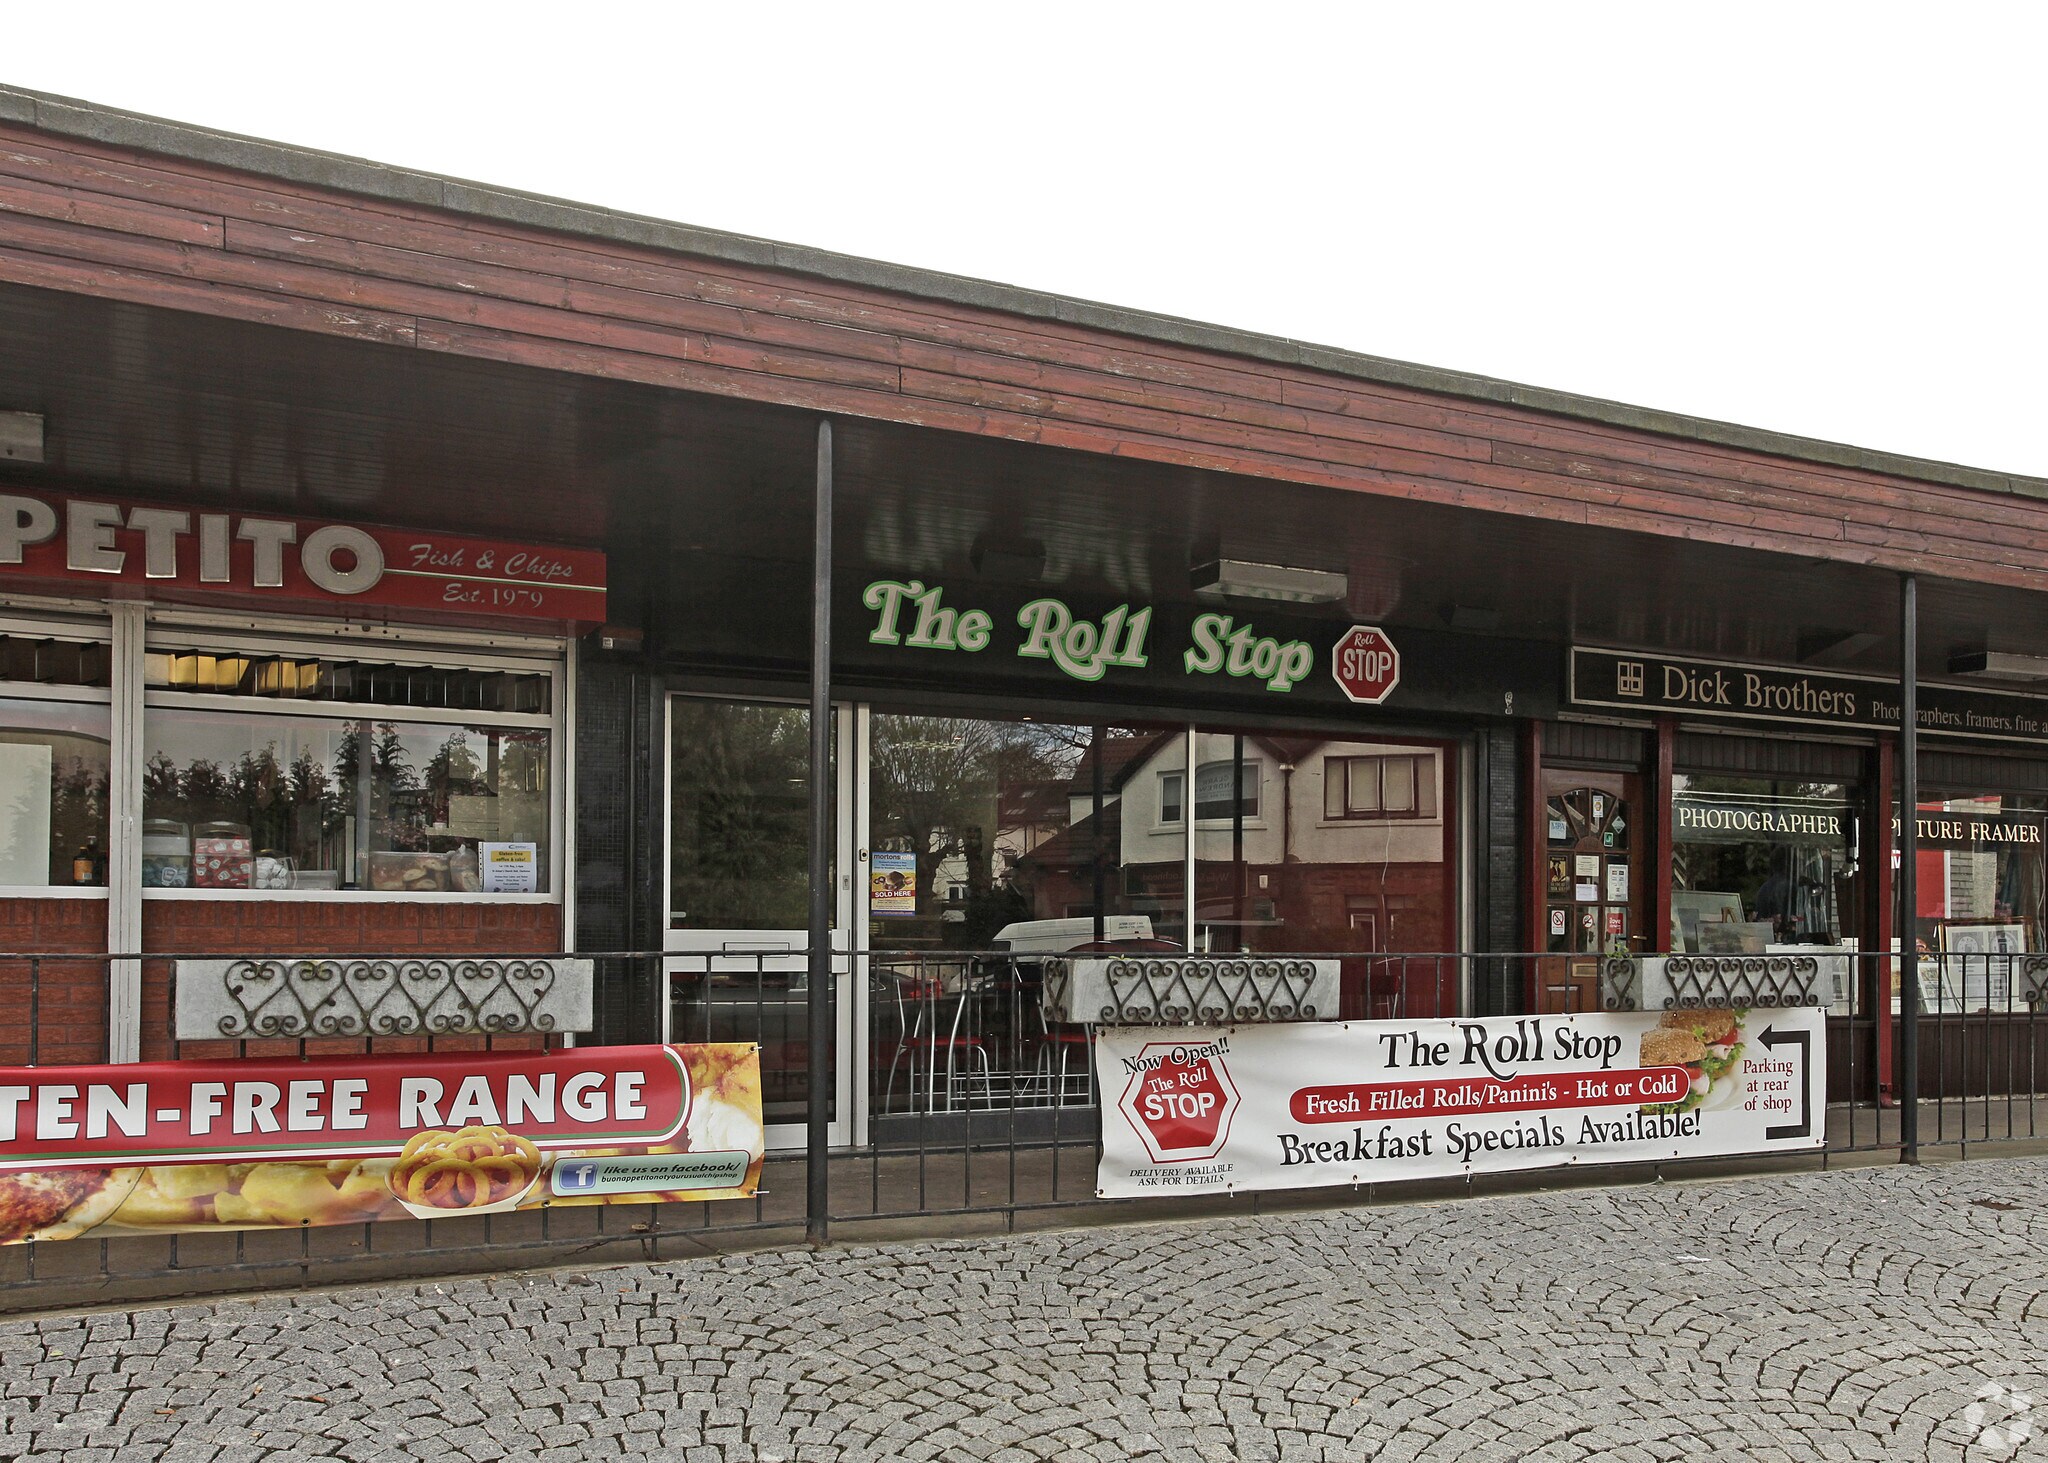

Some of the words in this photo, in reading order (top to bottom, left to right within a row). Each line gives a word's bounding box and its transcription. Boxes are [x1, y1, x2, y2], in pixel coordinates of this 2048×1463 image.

[409, 544, 464, 567] Fish
[476, 550, 495, 570] &
[504, 552, 573, 580] Chips
[862, 580, 993, 652] The
[1017, 598, 1152, 682] Roll
[1183, 612, 1313, 692] Stop
[1354, 633, 1375, 647] Roll
[1343, 648, 1392, 683] STOP
[1662, 665, 1731, 705] Dick
[1743, 673, 1856, 716] Brothers
[2015, 715, 2038, 733] fine
[1678, 807, 1841, 835] PHOTOGRAPHER
[1970, 822, 2040, 843] FRAMER
[1121, 1055, 1163, 1075] Now
[1170, 1036, 1230, 1066] Open!!
[1379, 1030, 1450, 1068] The
[1459, 1019, 1544, 1082] Roll
[1553, 1026, 1622, 1069] Stop
[1148, 1077, 1174, 1093] The
[1178, 1067, 1208, 1088] Roll
[1742, 1058, 1794, 1077] Parking
[1306, 1092, 1360, 1115] Fresh
[1368, 1087, 1425, 1111] Filled
[1576, 1079, 1608, 1100] Hot
[1615, 1083, 1632, 1097] or
[1638, 1074, 1677, 1096] Cold
[1746, 1078, 1759, 1092] at
[1763, 1079, 1789, 1092] rear
[399, 1070, 648, 1130] RANGE
[1145, 1092, 1215, 1120] STOP
[1744, 1095, 1758, 1112] of
[1763, 1094, 1793, 1113] shop
[1277, 1125, 1433, 1166] Breakfast
[1446, 1116, 1565, 1164] Specials
[1576, 1109, 1701, 1145] Available!
[603, 1166, 629, 1174] like
[671, 1162, 741, 1173] facebook/
[1129, 1167, 1182, 1177] DELIVERY
[1184, 1163, 1234, 1176] AVAILABLE
[1138, 1177, 1159, 1186] ASK
[1162, 1176, 1181, 1185] FOR
[1185, 1174, 1224, 1185] DETAILS
